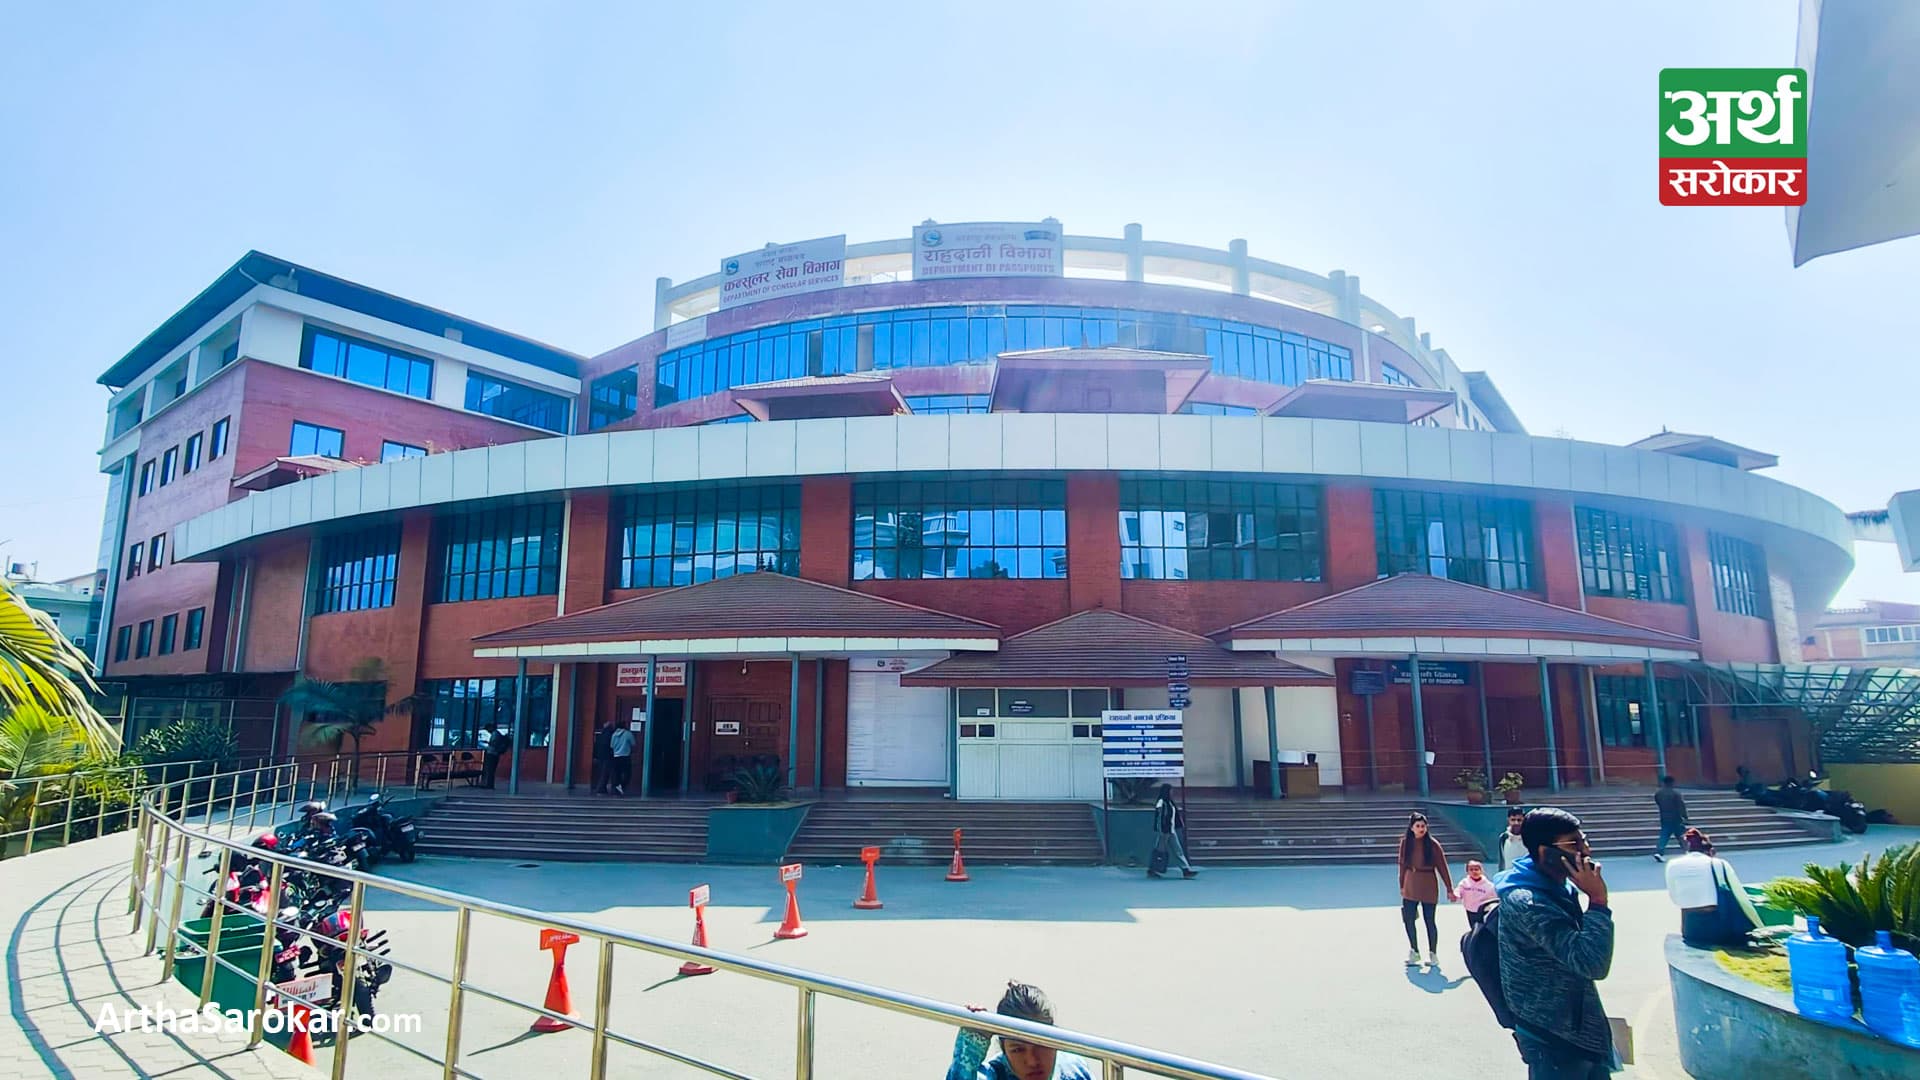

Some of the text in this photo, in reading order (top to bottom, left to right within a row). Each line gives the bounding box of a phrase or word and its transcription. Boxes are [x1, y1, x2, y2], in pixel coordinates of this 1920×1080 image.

[922, 243, 1052, 263] राहदानी विभाग
[723, 271, 770, 293] कन्सुलर
[775, 265, 798, 281] सेवा
[802, 259, 841, 276] विभाग
[921, 263, 1056, 275] DEPARTMENT OF PASSPORTS
[723, 289, 762, 303] DEPARTMENT
[771, 280, 807, 293] CONSULAR
[808, 273, 840, 286] SERVICES
